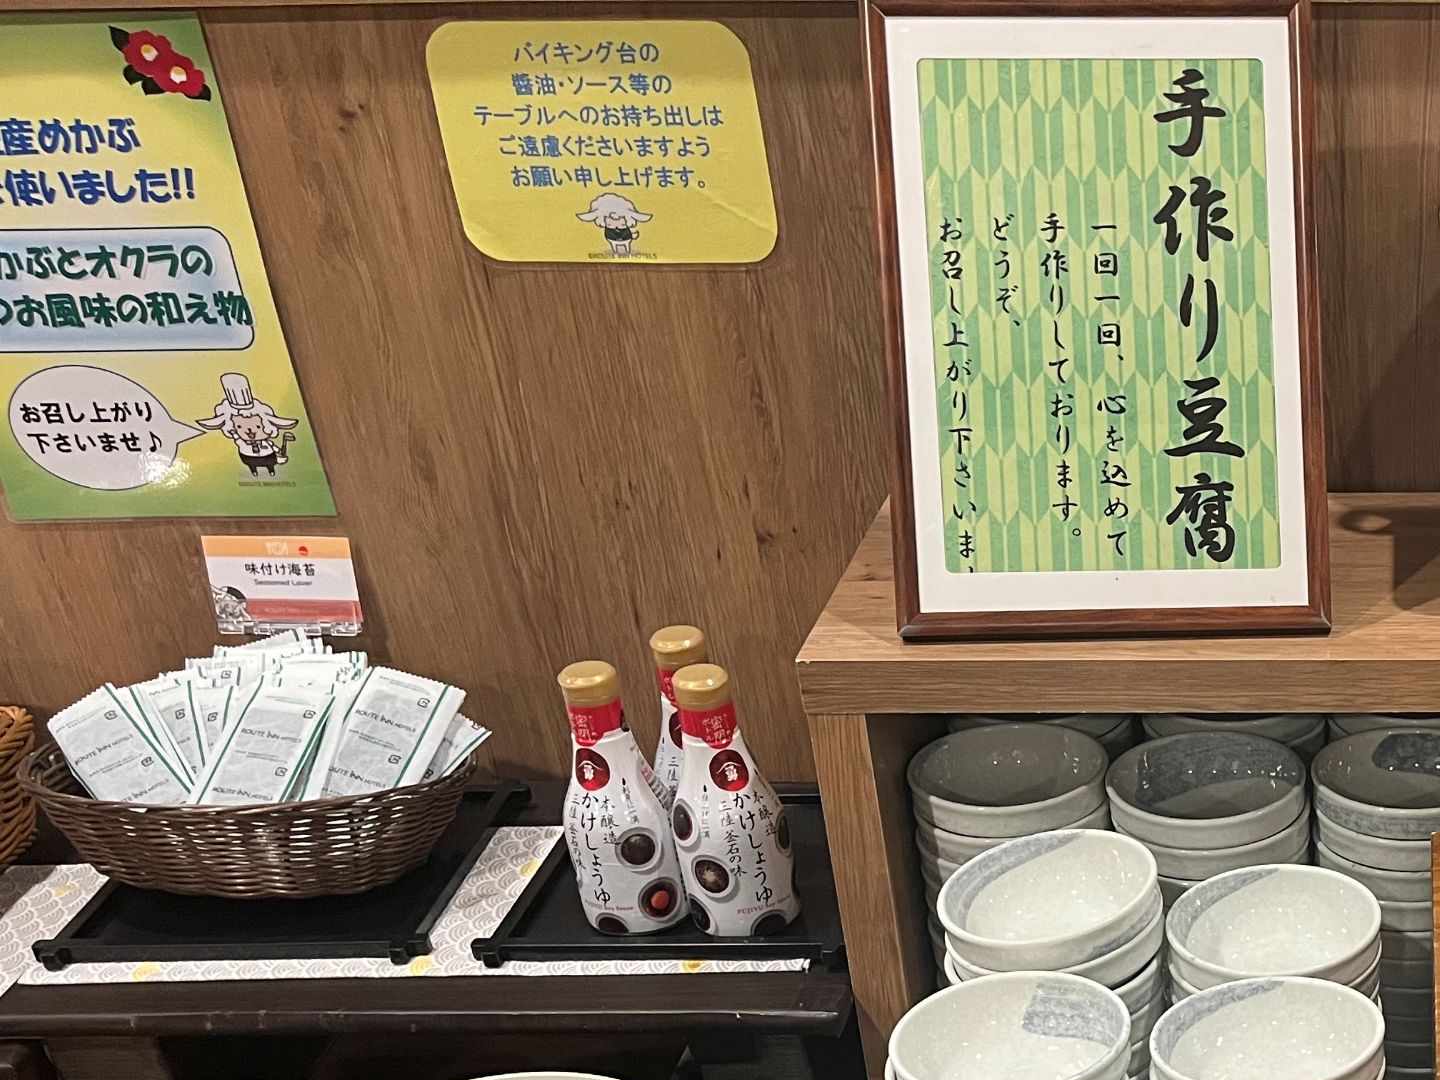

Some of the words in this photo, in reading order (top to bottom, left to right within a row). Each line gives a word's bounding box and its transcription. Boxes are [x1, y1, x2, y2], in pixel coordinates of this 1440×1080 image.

[514, 41, 659, 65] バイキング台の
[473, 104, 724, 128] テーブルへのお持ち出しは
[0, 118, 141, 155] 産めかぶ
[498, 134, 711, 158] ご遠慮くださいますよう
[0, 168, 195, 206] 使いました!!
[510, 165, 706, 189] お願い申し上げます。
[992, 212, 1021, 328] どうぞ、
[1153, 68, 1246, 563] 手作り豆腐
[938, 216, 977, 573] お召し上がり下さいま
[1039, 212, 1082, 539] 手作りしております。
[1090, 225, 1132, 557] 一回一回、心を込めて
[20, 401, 153, 425] お召し上がり
[245, 563, 315, 576] 味付け海苔
[581, 792, 611, 904] かけしょうゆ
[732, 792, 773, 903] かけしょうゆ
